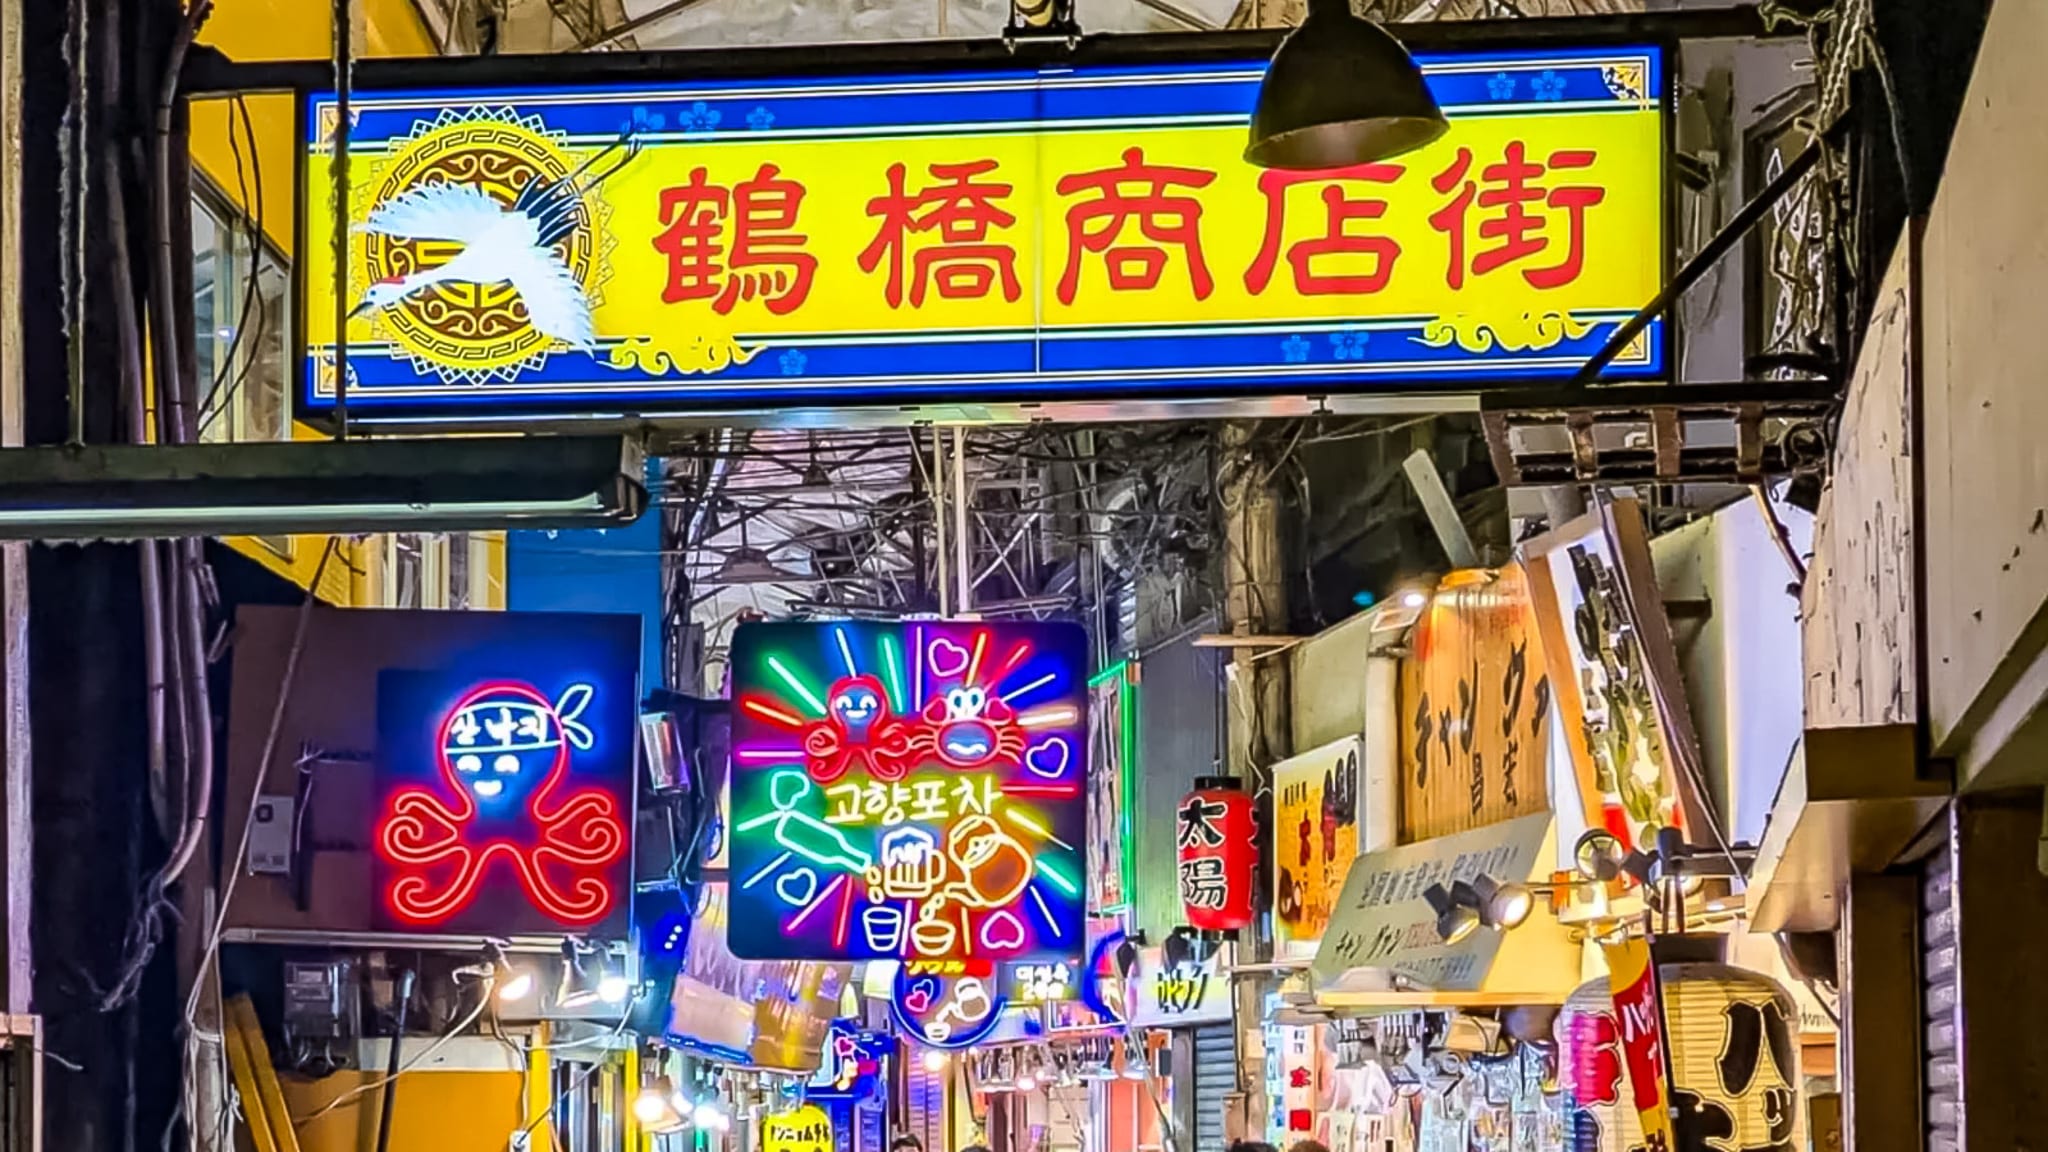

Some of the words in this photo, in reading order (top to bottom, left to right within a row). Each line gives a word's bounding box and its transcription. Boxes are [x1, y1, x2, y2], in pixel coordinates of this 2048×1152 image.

[652, 140, 1606, 316] 鶴橋商店街
[823, 774, 1005, 827] 고향포차
[1177, 796, 1229, 912] 太陽
